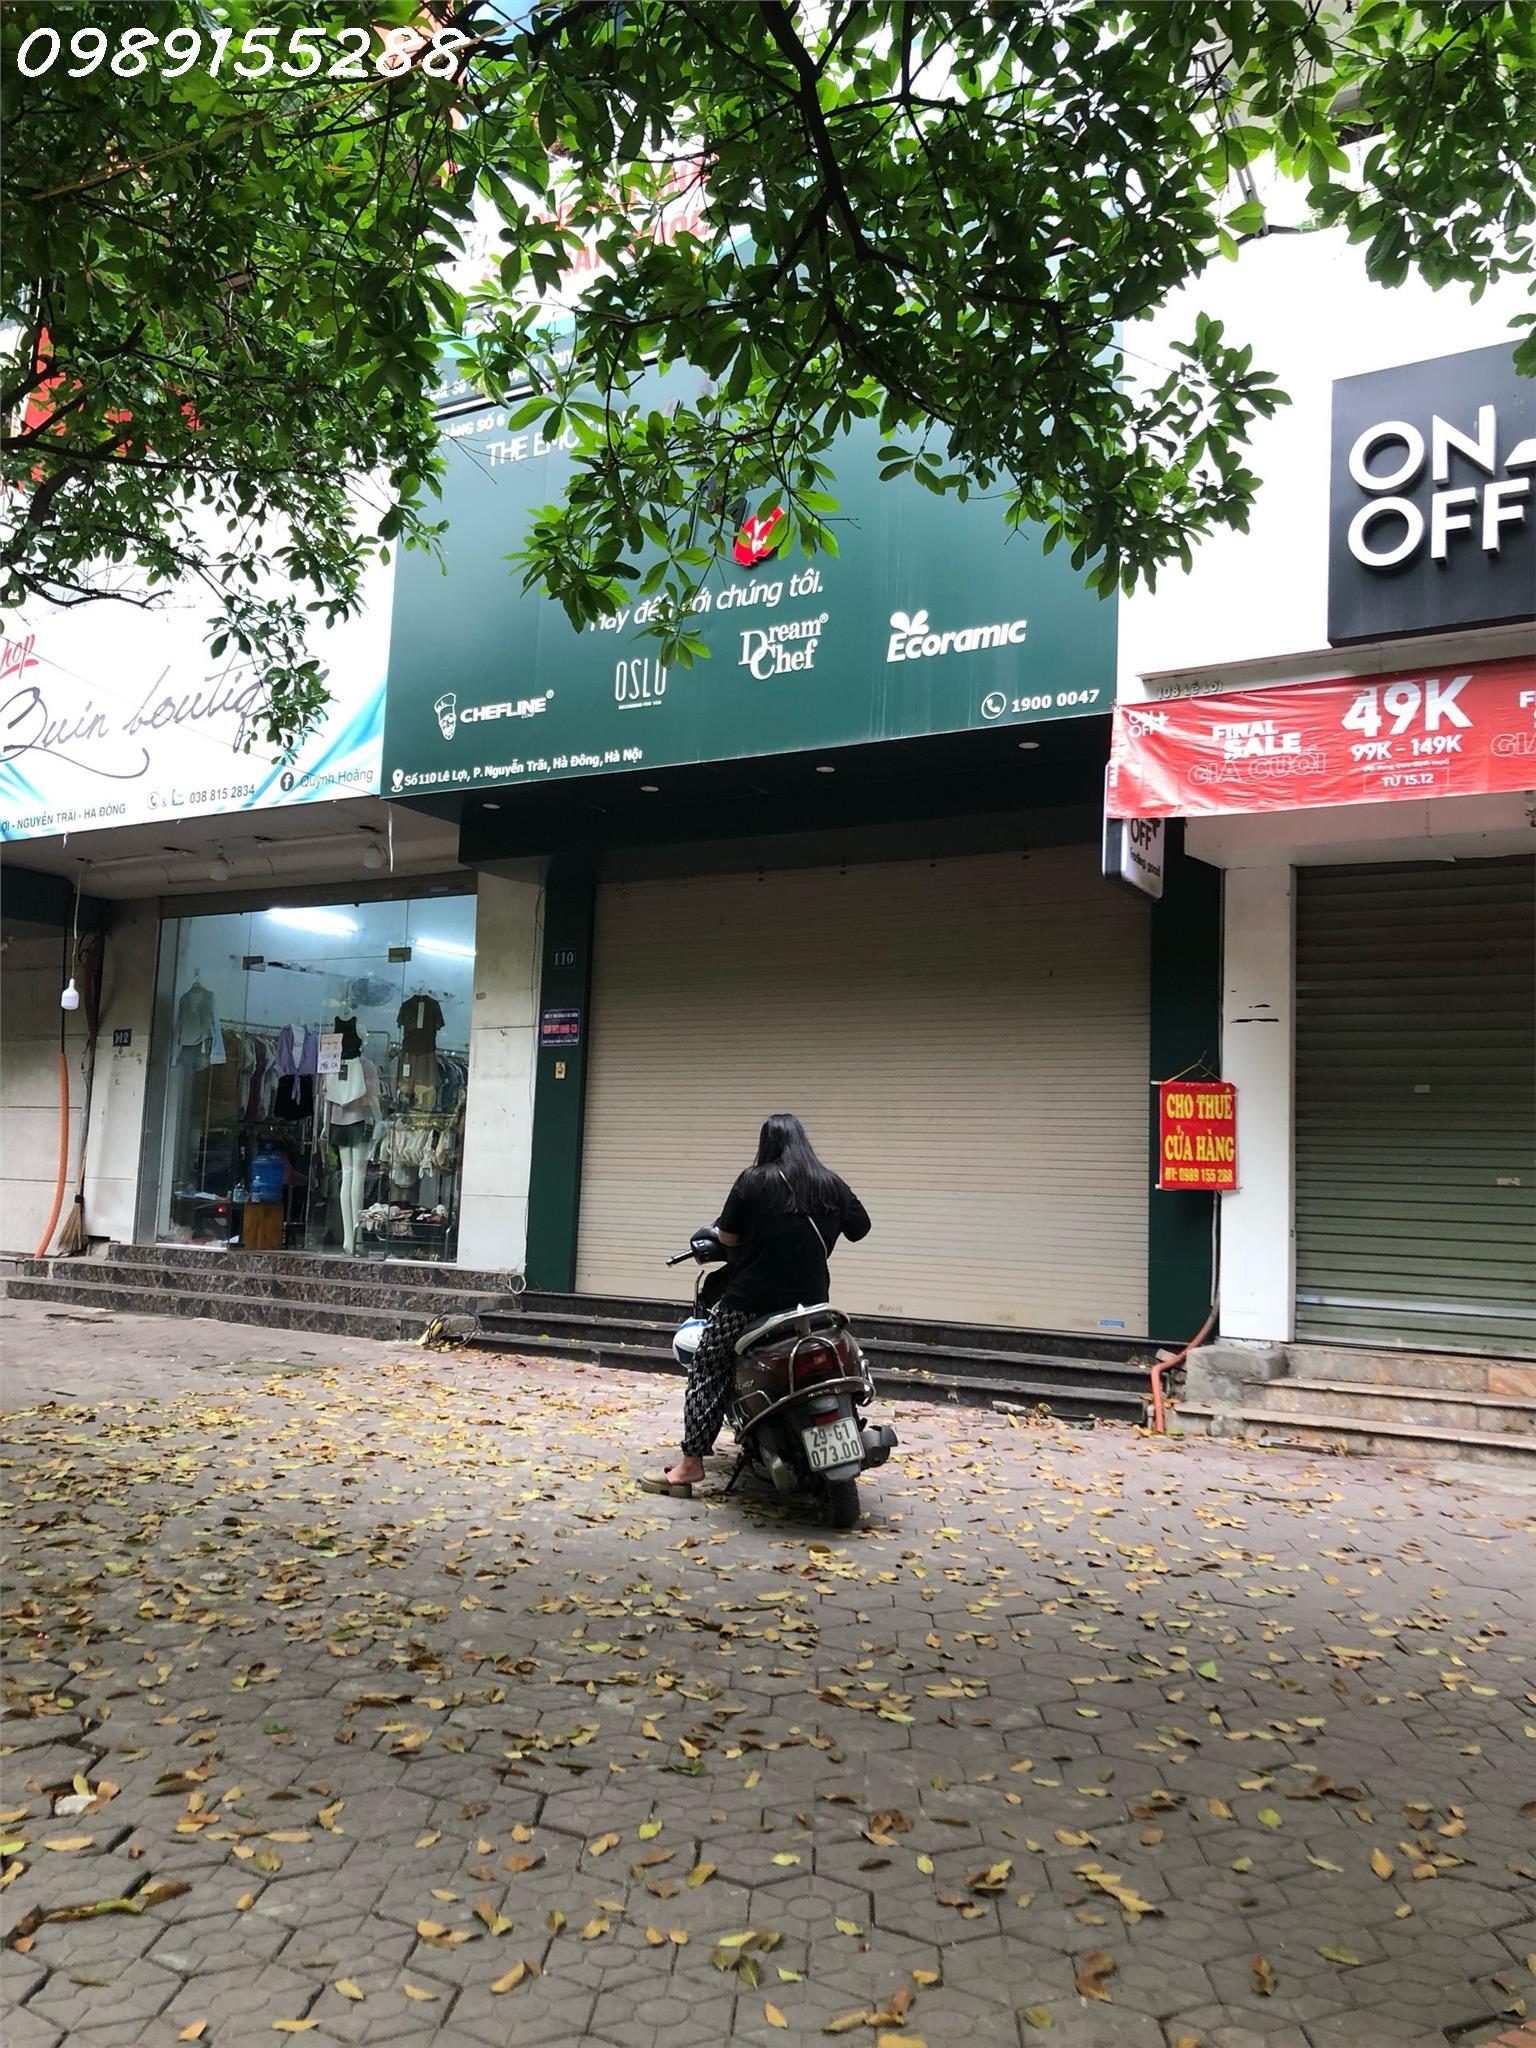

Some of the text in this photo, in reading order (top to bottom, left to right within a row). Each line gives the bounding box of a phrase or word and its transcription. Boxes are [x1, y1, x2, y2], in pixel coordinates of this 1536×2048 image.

[486, 435, 529, 468] THE
[1348, 404, 1496, 491] ON
[1347, 477, 1531, 568] OFF
[716, 579, 783, 608] chúng
[789, 568, 824, 598] tôi.
[887, 620, 1027, 663] Ecoramic
[749, 638, 818, 680] Chef
[460, 698, 547, 724] CHEFLINE
[1011, 689, 1100, 713] 1900 0047
[1341, 674, 1474, 738] 49K
[1212, 719, 1279, 741] FINAL
[1222, 732, 1302, 761] SALE
[1351, 741, 1393, 762] 99K
[1411, 734, 1464, 756] 149K
[418, 773, 438, 785] 110
[437, 769, 450, 783] Lê
[484, 759, 524, 779] Nguyễn
[526, 759, 551, 774] Trãi,
[553, 755, 568, 770] Hà
[570, 753, 604, 769] Đông,
[604, 749, 621, 764] Hà
[622, 747, 643, 763] Nội
[1404, 772, 1434, 786] 15.12
[189, 791, 208, 804] 038
[210, 787, 229, 801] 815
[231, 784, 256, 799] 2834
[1130, 818, 1152, 851] OFF
[554, 951, 574, 967] 110
[1166, 1086, 1234, 1120] CHO THUÊ
[1164, 1124, 1235, 1162] CỬA HÀNG
[810, 1422, 851, 1448] 29-G1
[811, 1439, 860, 1467] 073.00
